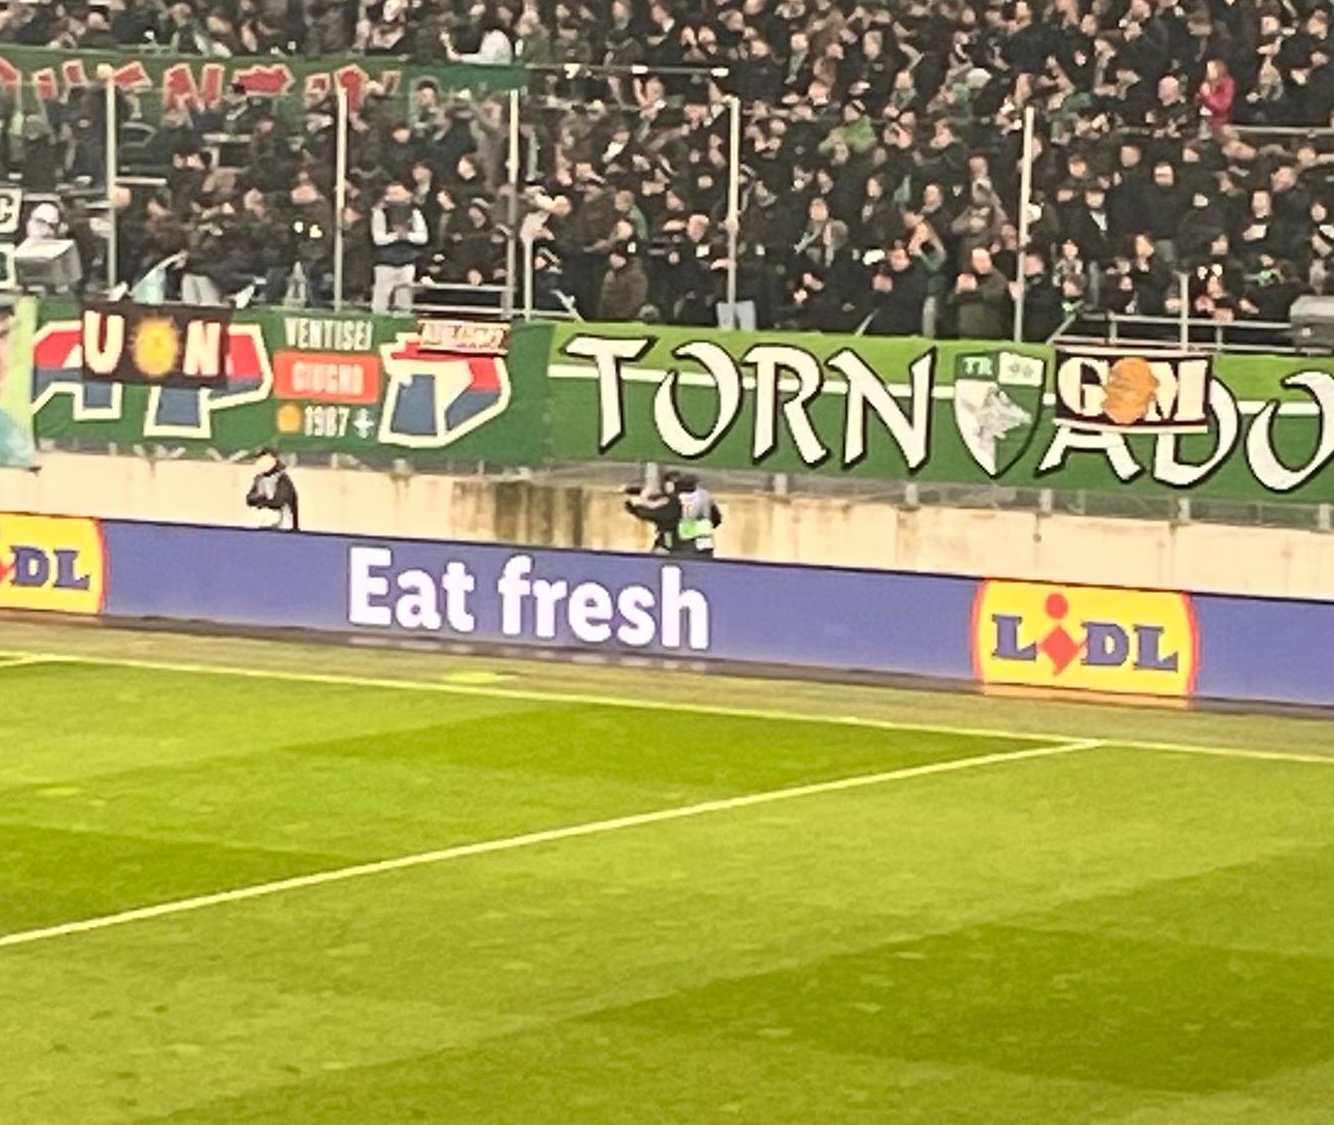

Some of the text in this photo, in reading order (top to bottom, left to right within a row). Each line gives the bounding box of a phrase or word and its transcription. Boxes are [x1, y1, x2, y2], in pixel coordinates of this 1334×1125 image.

[284, 317, 375, 351] VENTISEI
[348, 545, 710, 651] Eat fresh
[990, 592, 1179, 675] LIDL
